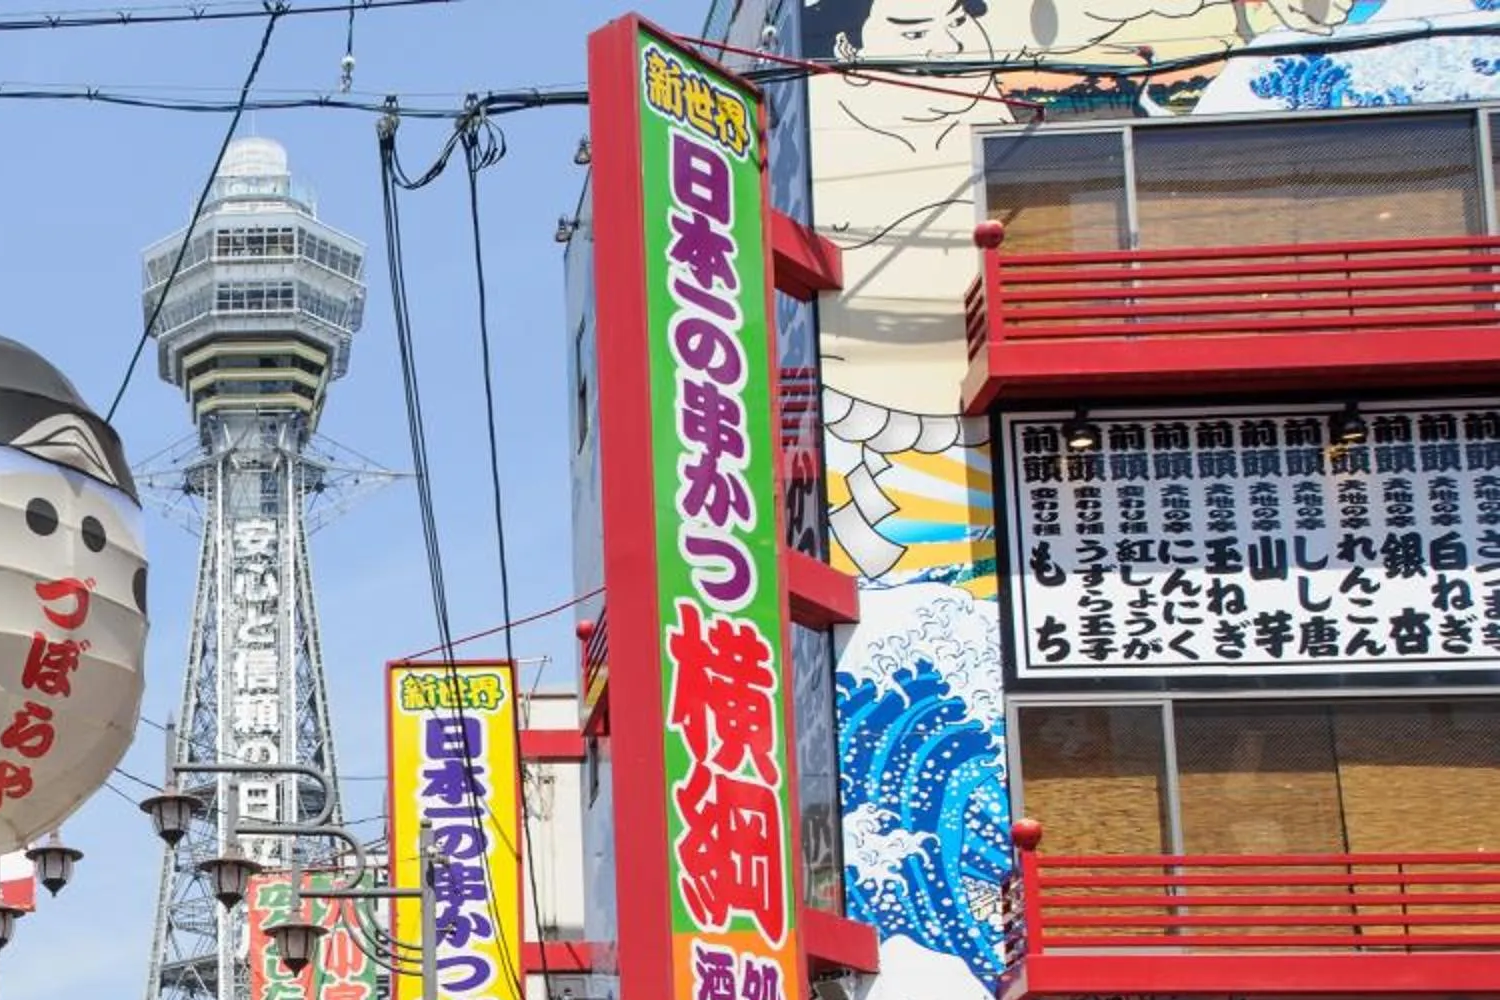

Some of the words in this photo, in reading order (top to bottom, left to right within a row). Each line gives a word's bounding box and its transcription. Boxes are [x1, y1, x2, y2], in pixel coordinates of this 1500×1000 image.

[646, 50, 750, 153] 新世界
[671, 135, 752, 602] 日本一の串かつ
[1022, 425, 1063, 483] 前頭
[1108, 424, 1150, 481] 前頭
[1151, 422, 1193, 480] 前頭
[1195, 420, 1239, 479] 前頭
[1239, 419, 1283, 478] 前頭
[1284, 418, 1328, 477] 前頭
[1372, 415, 1417, 474] 前頭
[1417, 413, 1462, 473] 前頭
[1463, 412, 1500, 472] 前頭
[1029, 541, 1071, 662] もち
[1073, 539, 1119, 661] うずら玉子
[1115, 538, 1163, 660] 紅しょうが
[1157, 538, 1205, 660] にんにく
[1204, 536, 1252, 659] 玉ねぎ
[1247, 535, 1295, 659] 山芋
[1293, 535, 1341, 658] しし唐
[1336, 533, 1387, 656] れんこん
[1380, 531, 1432, 656] 銀杏
[1429, 530, 1479, 655] 白ねぎ
[402, 673, 504, 713] 新世界
[671, 604, 787, 944] 横綱
[423, 718, 492, 990] 日本一の串かつ
